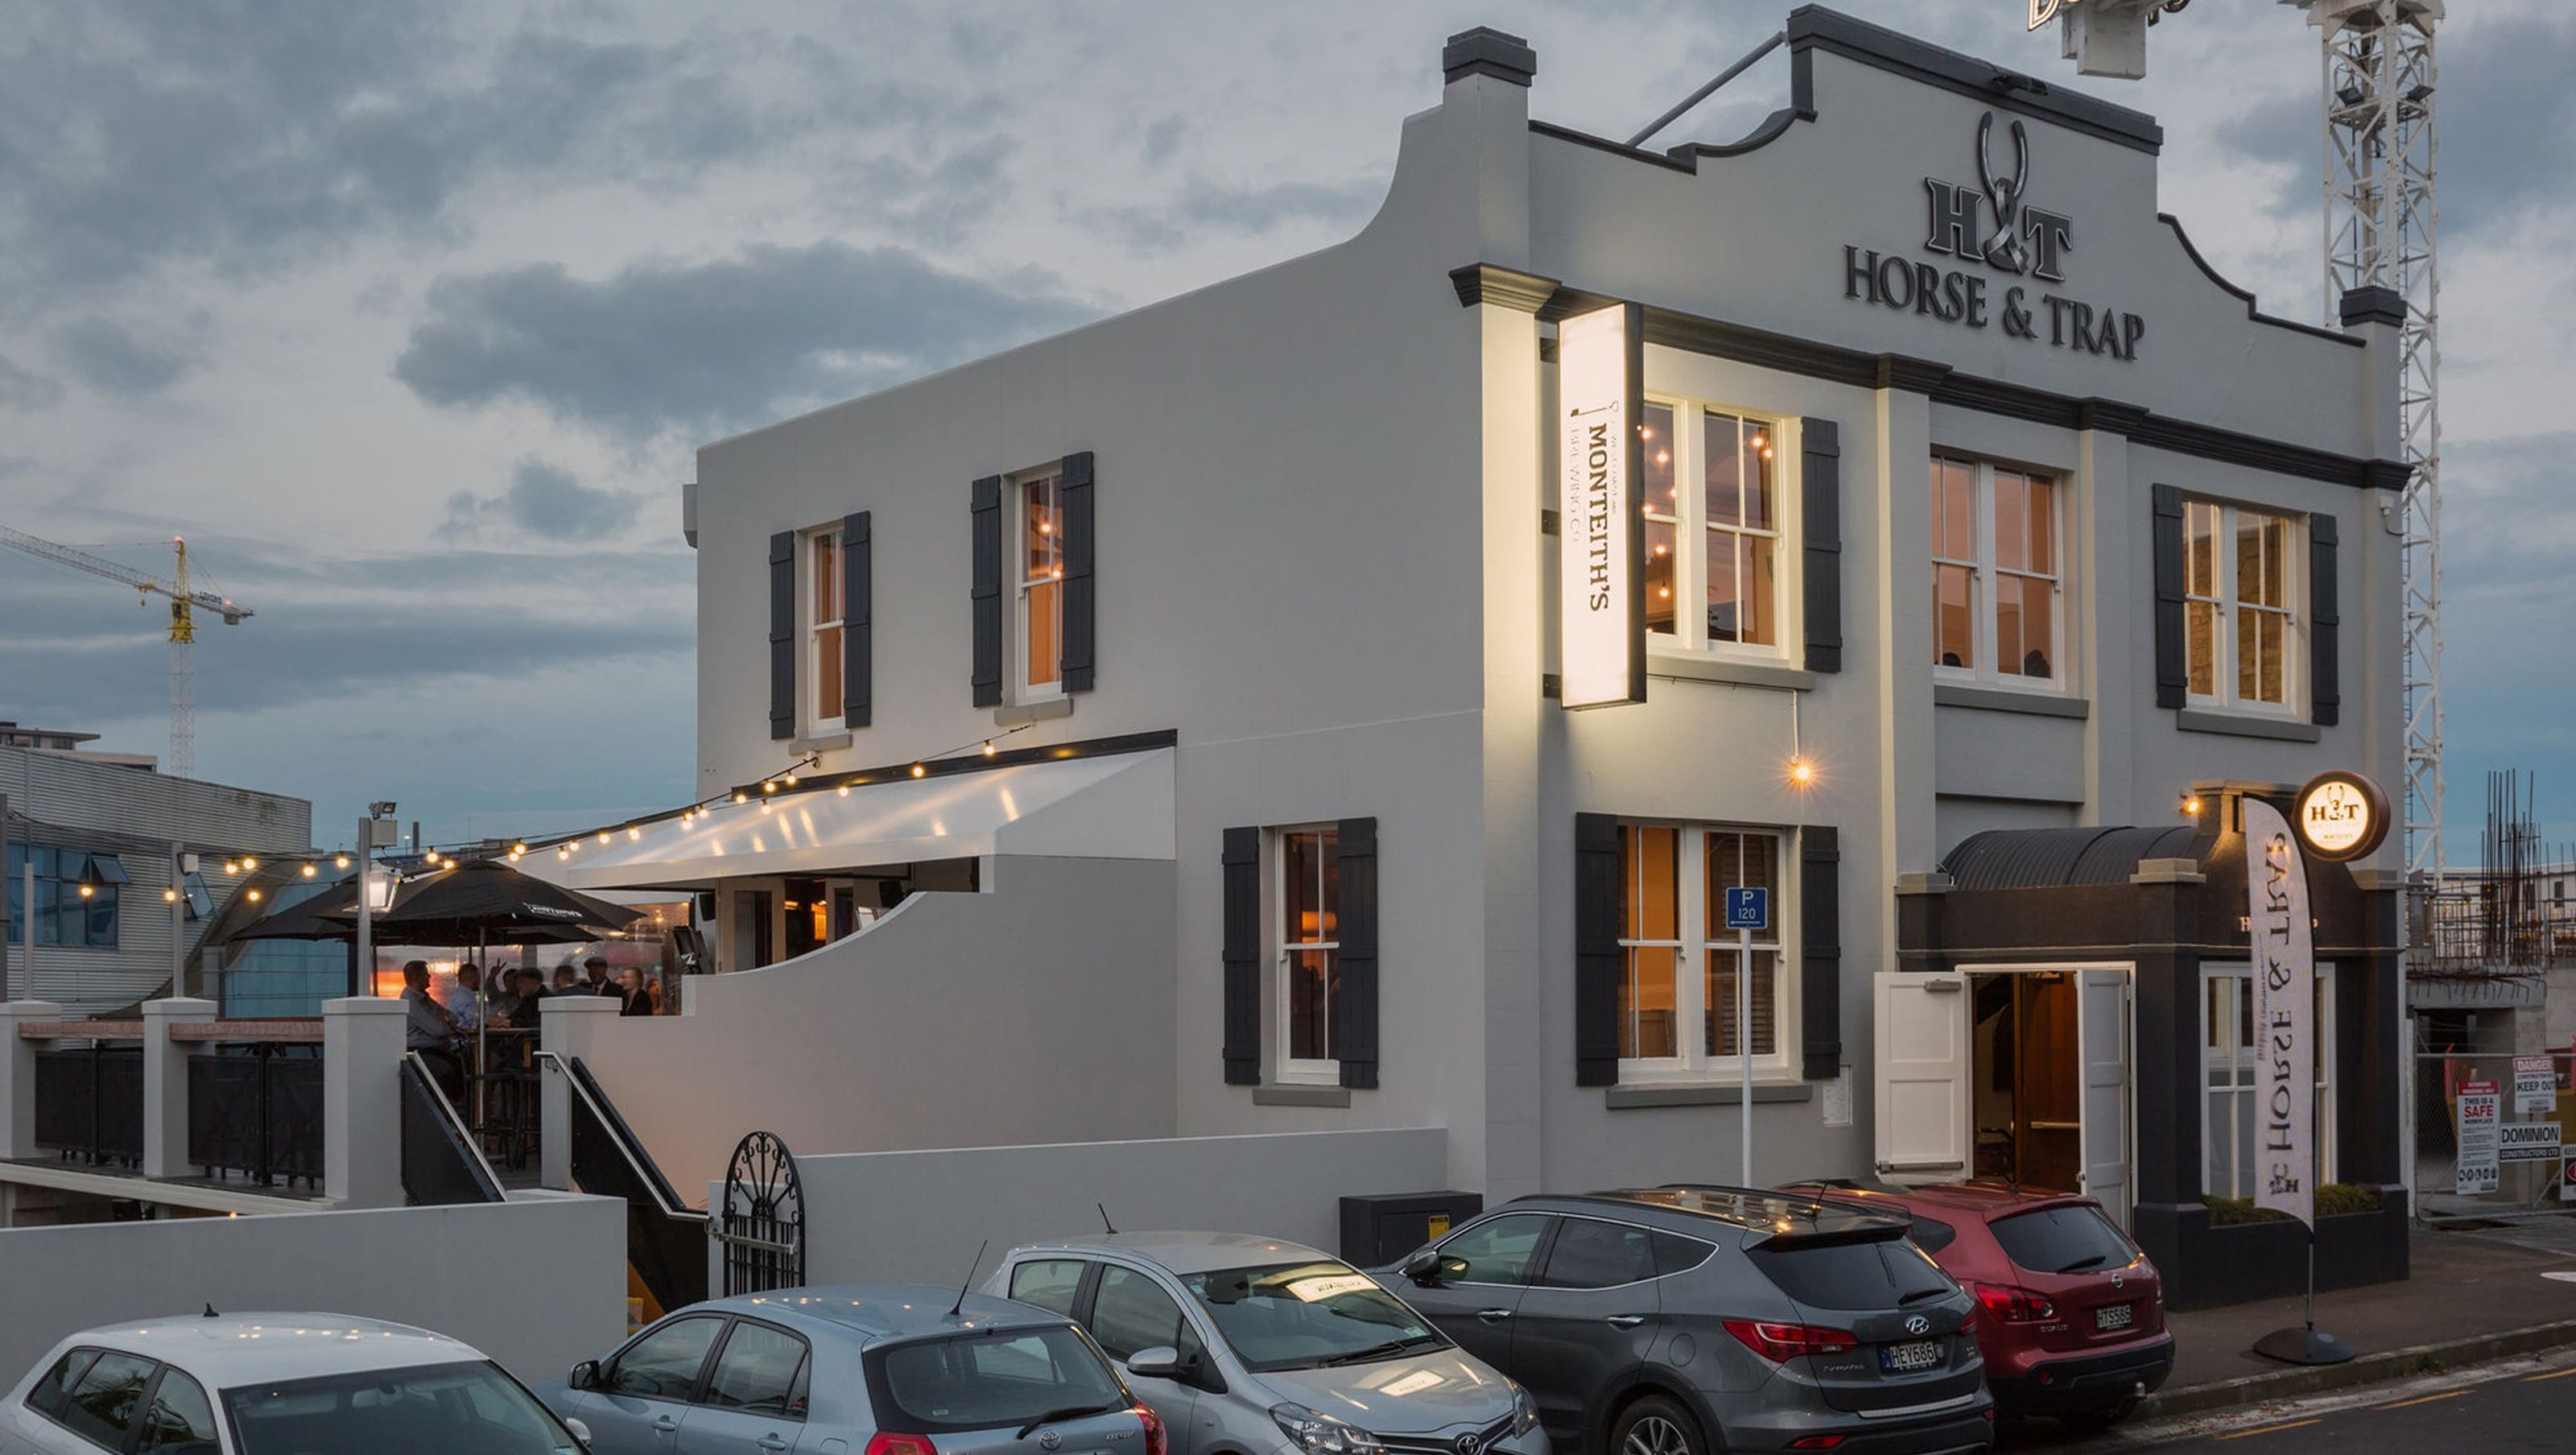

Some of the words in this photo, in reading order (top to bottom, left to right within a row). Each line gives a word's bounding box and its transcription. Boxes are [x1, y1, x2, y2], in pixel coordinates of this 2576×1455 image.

[1844, 244, 1988, 329] HORSE
[2004, 287, 2039, 339] &
[2043, 293, 2145, 361] TRAP
[1588, 423, 1609, 612] MONTEITH'S
[1742, 891, 1754, 905] P
[1739, 907, 1756, 920] 120
[2516, 1081, 2539, 1093] KEEP
[2464, 1105, 2493, 1118] SAFE
[2502, 1126, 2558, 1143] DOMINION
[1892, 1344, 1934, 1366] HEY686
